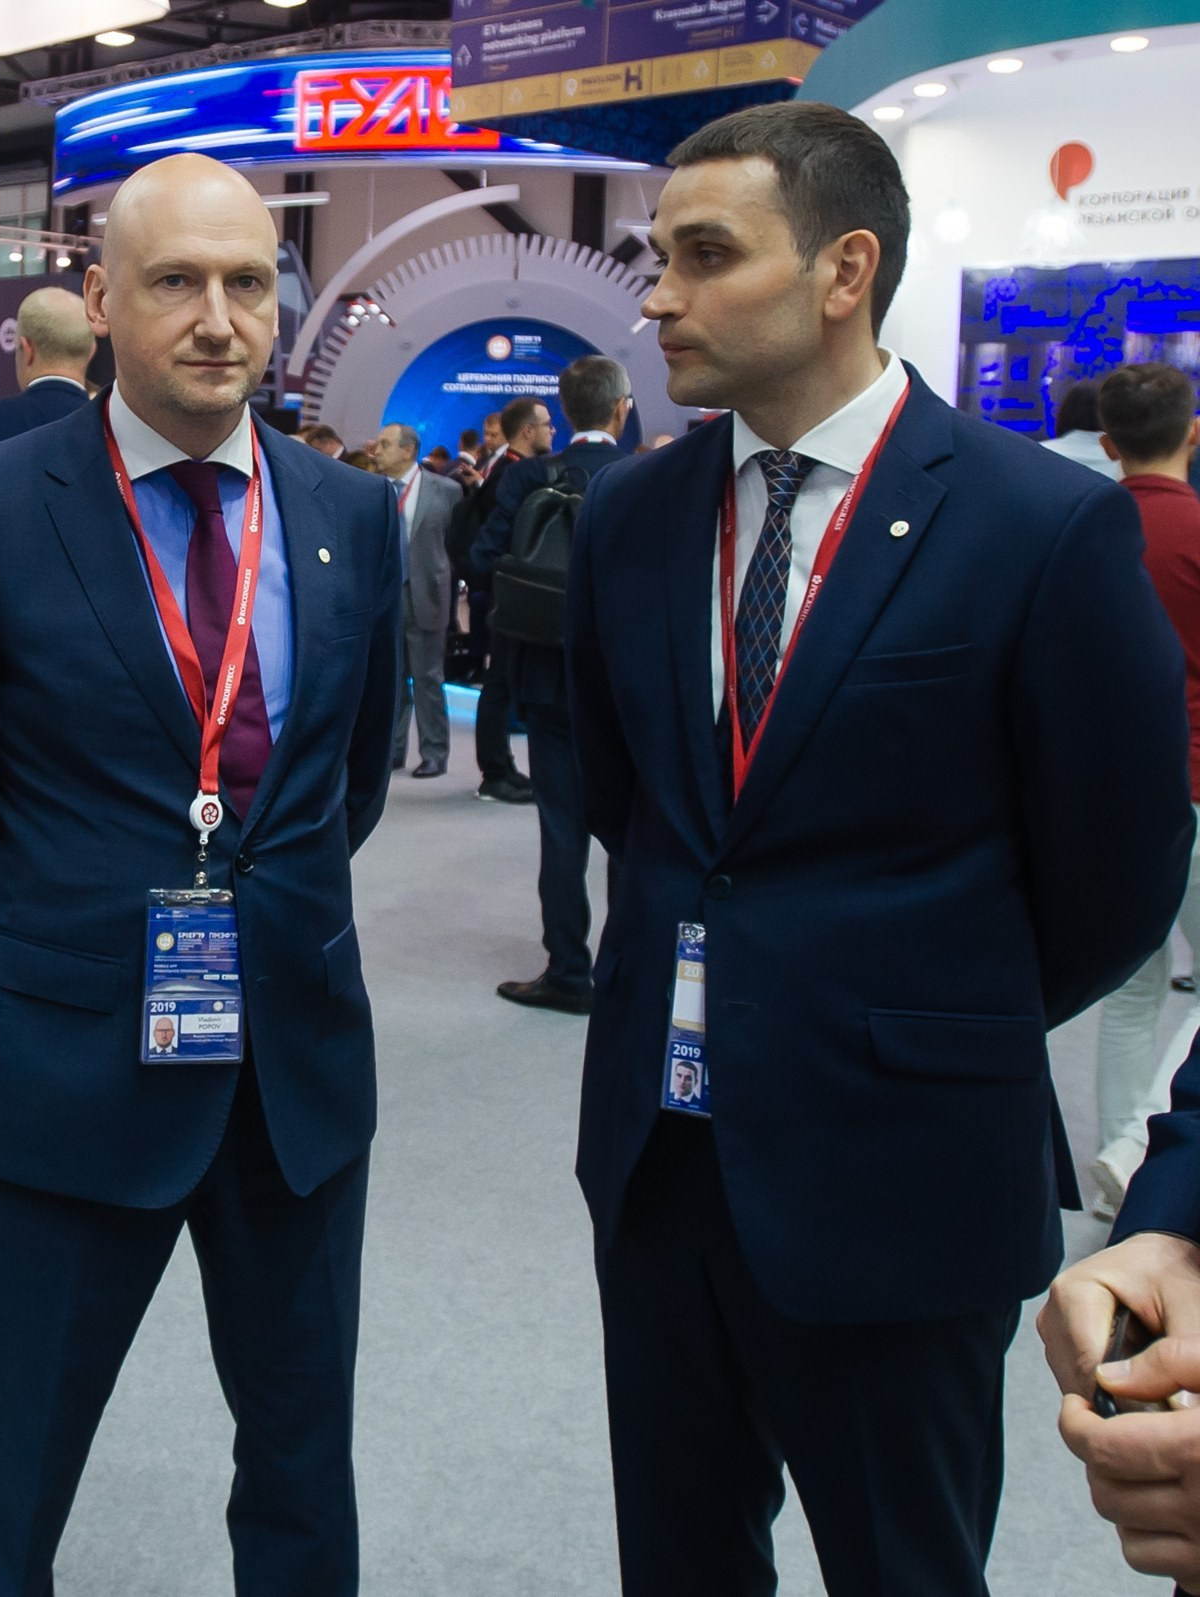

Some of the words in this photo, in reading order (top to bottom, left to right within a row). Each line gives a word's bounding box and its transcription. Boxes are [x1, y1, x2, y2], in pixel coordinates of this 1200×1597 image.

[483, 23, 497, 36] EY
[541, 26, 586, 44] platform
[624, 65, 643, 92] H
[1079, 186, 1189, 205] КОРПОРАЦИЯ
[457, 372, 512, 383] ЦЕРЕМОНИЯ
[504, 386, 512, 394] О
[513, 385, 559, 395] СОТРУДНИ
[240, 568, 252, 617] ROSCONGRESS
[220, 664, 236, 718] РОСКОНГРЕСС
[150, 1001, 176, 1013] 2019
[672, 1043, 701, 1060] 2019
